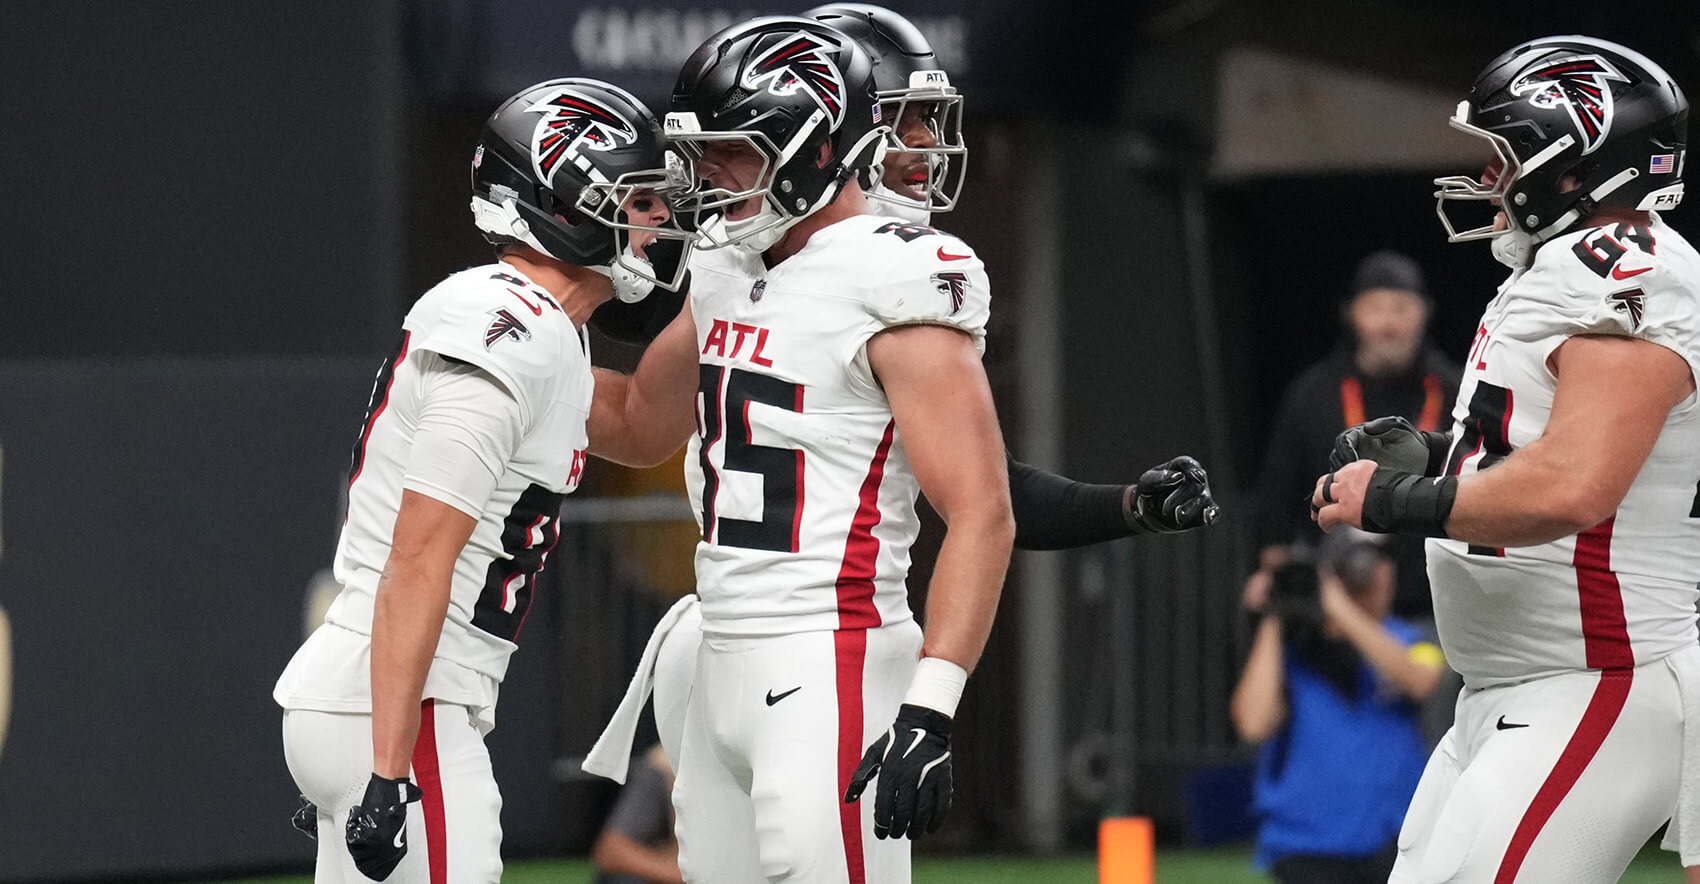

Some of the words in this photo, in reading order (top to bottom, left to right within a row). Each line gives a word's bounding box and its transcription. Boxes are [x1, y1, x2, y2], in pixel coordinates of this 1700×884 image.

[926, 73, 945, 82] ATL
[666, 118, 683, 128] ATL
[1571, 222, 1657, 279] 64
[702, 318, 773, 368] ATL
